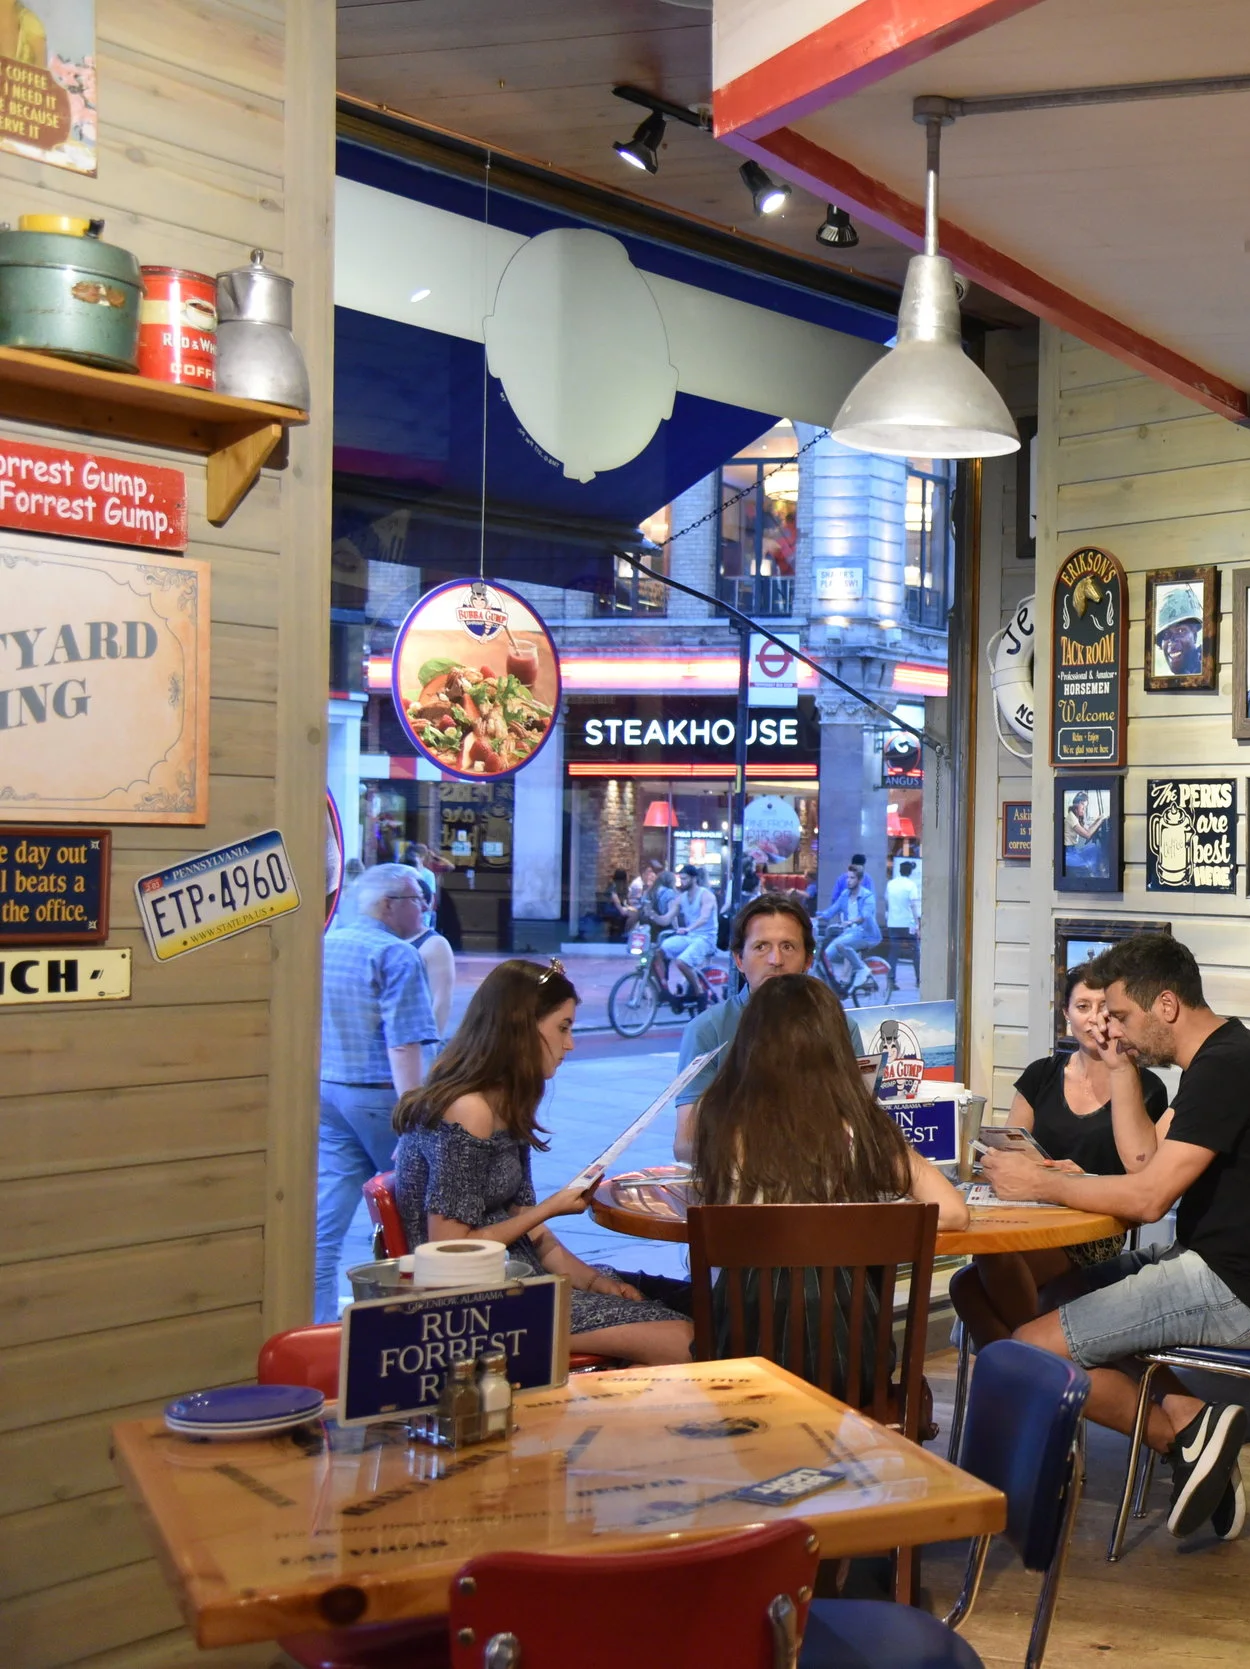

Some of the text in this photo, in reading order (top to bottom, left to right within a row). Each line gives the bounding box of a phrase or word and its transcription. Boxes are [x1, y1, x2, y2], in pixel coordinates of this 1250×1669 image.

[6, 65, 49, 91] COFFEE
[12, 84, 43, 106] NEED
[46, 95, 57, 110] IT
[9, 101, 60, 129] BECAUSE
[29, 124, 39, 140] IT
[0, 454, 74, 486] orrest
[103, 500, 175, 540] Gump.
[1061, 551, 1118, 587] ERIKSON'S
[1060, 632, 1115, 666] TACK ROOM
[1063, 681, 1110, 696] HORSEMEN
[1058, 699, 1116, 723] Welcome
[885, 776, 920, 786] ANGUS
[1150, 782, 1232, 809] The PERKS
[1196, 812, 1229, 834] are
[15, 840, 52, 870] day
[57, 844, 88, 864] out
[1192, 834, 1231, 864] best
[172, 845, 250, 881] PENNSYLVANIA
[15, 870, 68, 893] beats
[73, 875, 86, 893] a
[2, 898, 88, 923] the office.
[896, 1060, 924, 1079] GUMP
[460, 1291, 504, 1304] ALABAMA
[421, 1305, 492, 1342] RUN
[380, 1329, 528, 1378] FORREST
